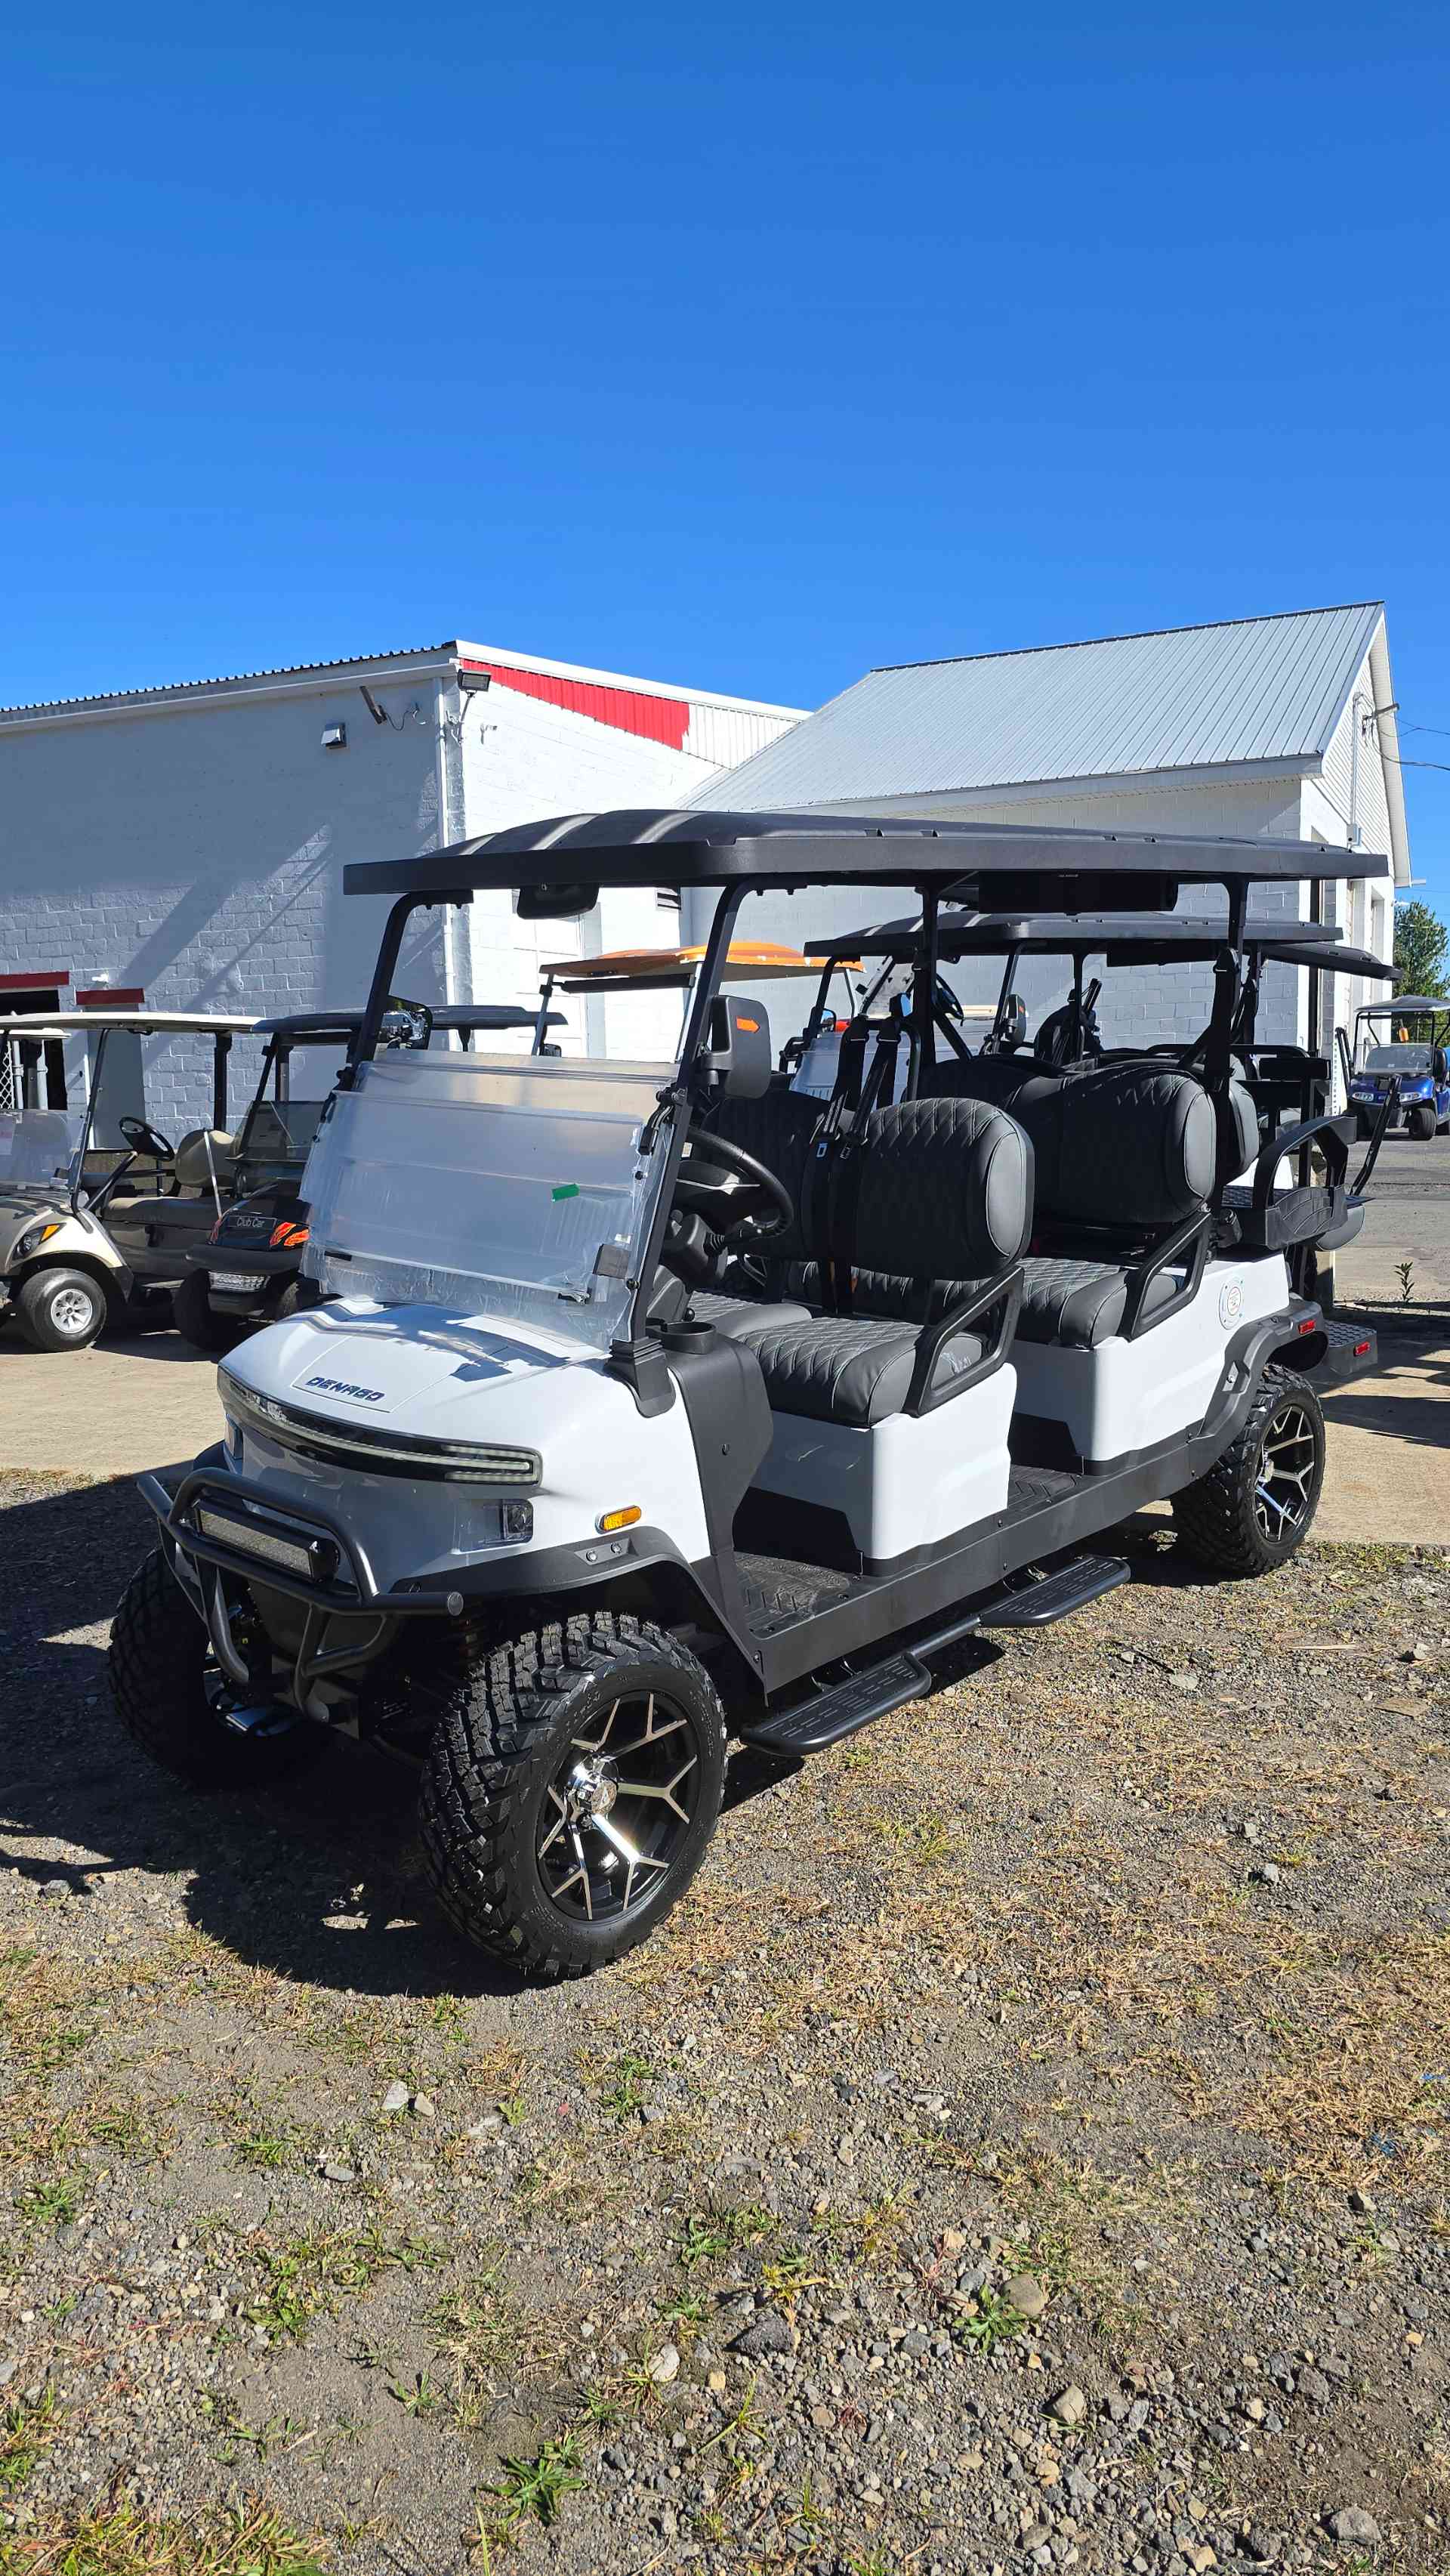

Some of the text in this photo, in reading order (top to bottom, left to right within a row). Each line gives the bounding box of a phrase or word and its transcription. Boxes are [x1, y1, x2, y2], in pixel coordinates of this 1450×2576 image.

[236, 1216, 265, 1228] Club Car
[305, 1376, 385, 1402] DENAGO
